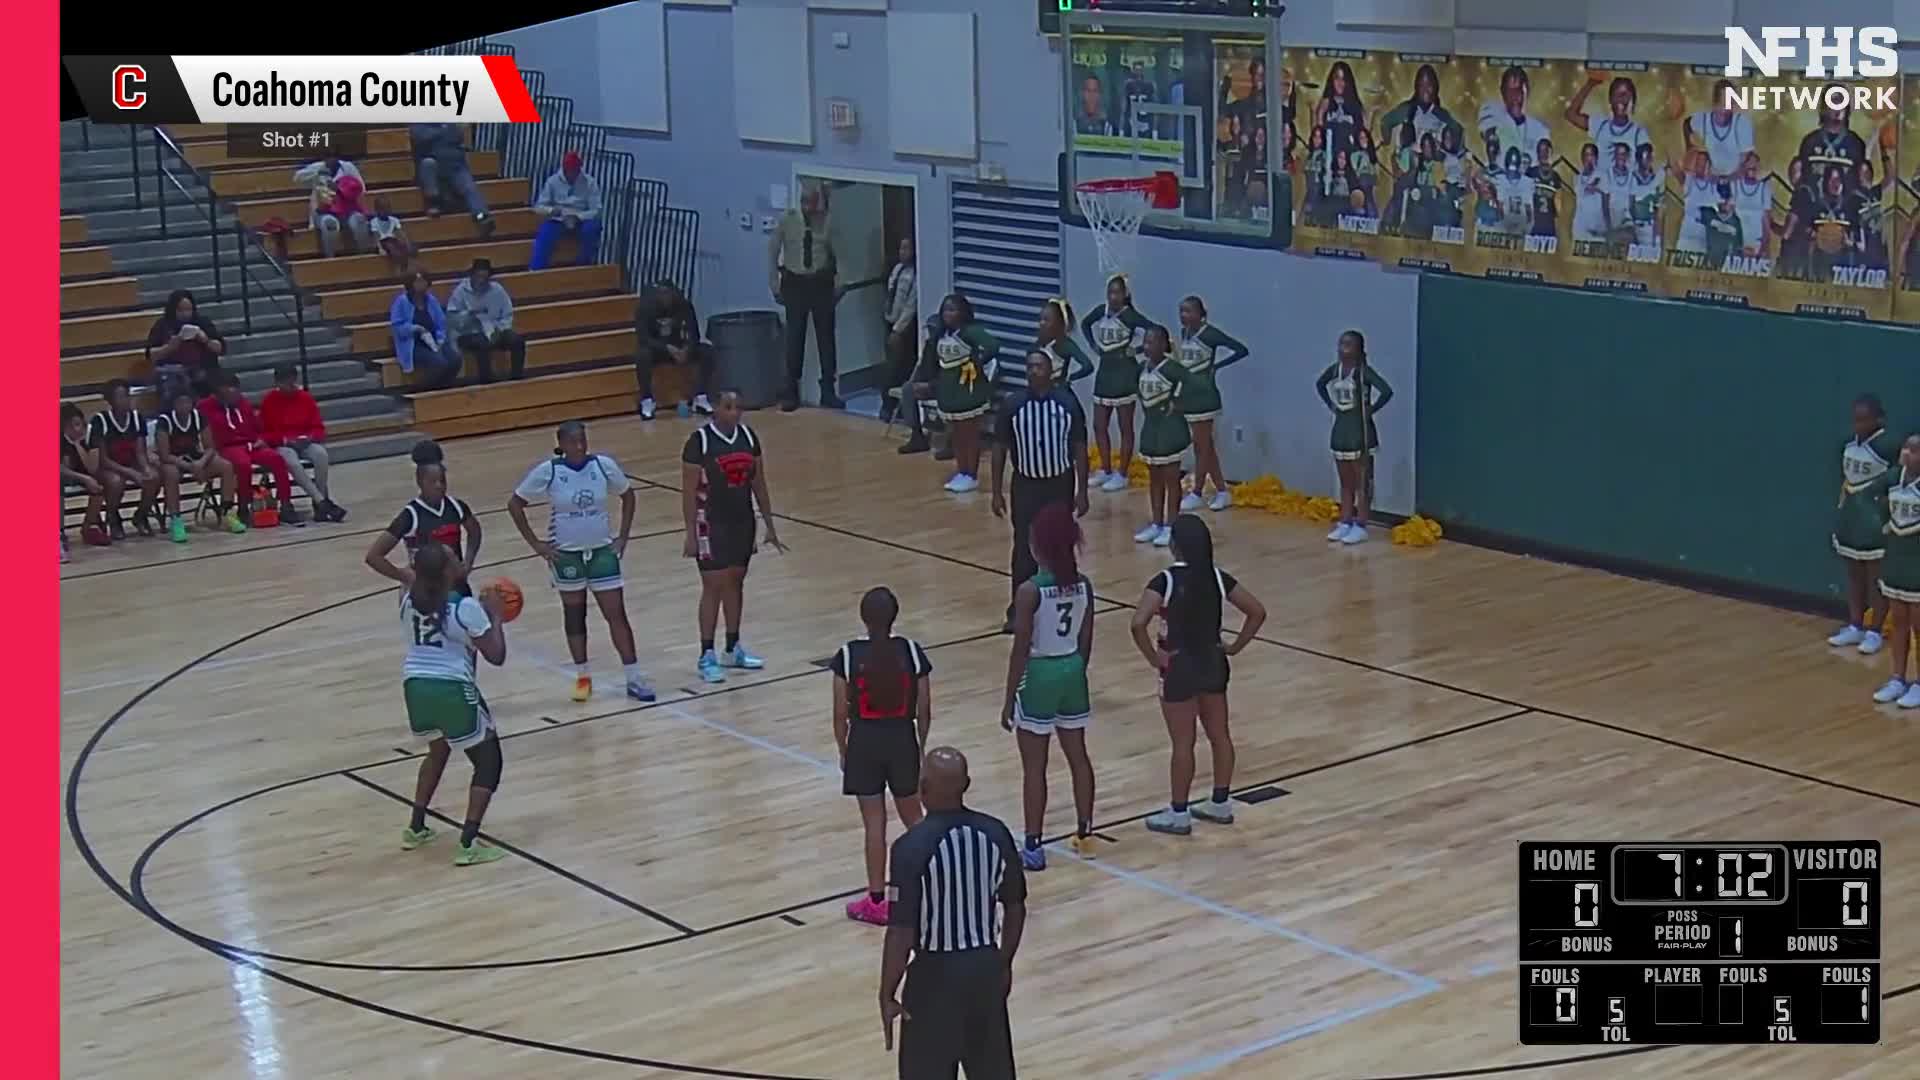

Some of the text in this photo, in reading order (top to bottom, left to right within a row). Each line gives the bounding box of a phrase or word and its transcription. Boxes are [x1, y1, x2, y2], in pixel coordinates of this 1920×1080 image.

[1721, 255, 1770, 277] ADAMS
[1832, 265, 1887, 289] TAYLOR
[414, 615, 443, 648] 12
[1056, 602, 1073, 637] 3
